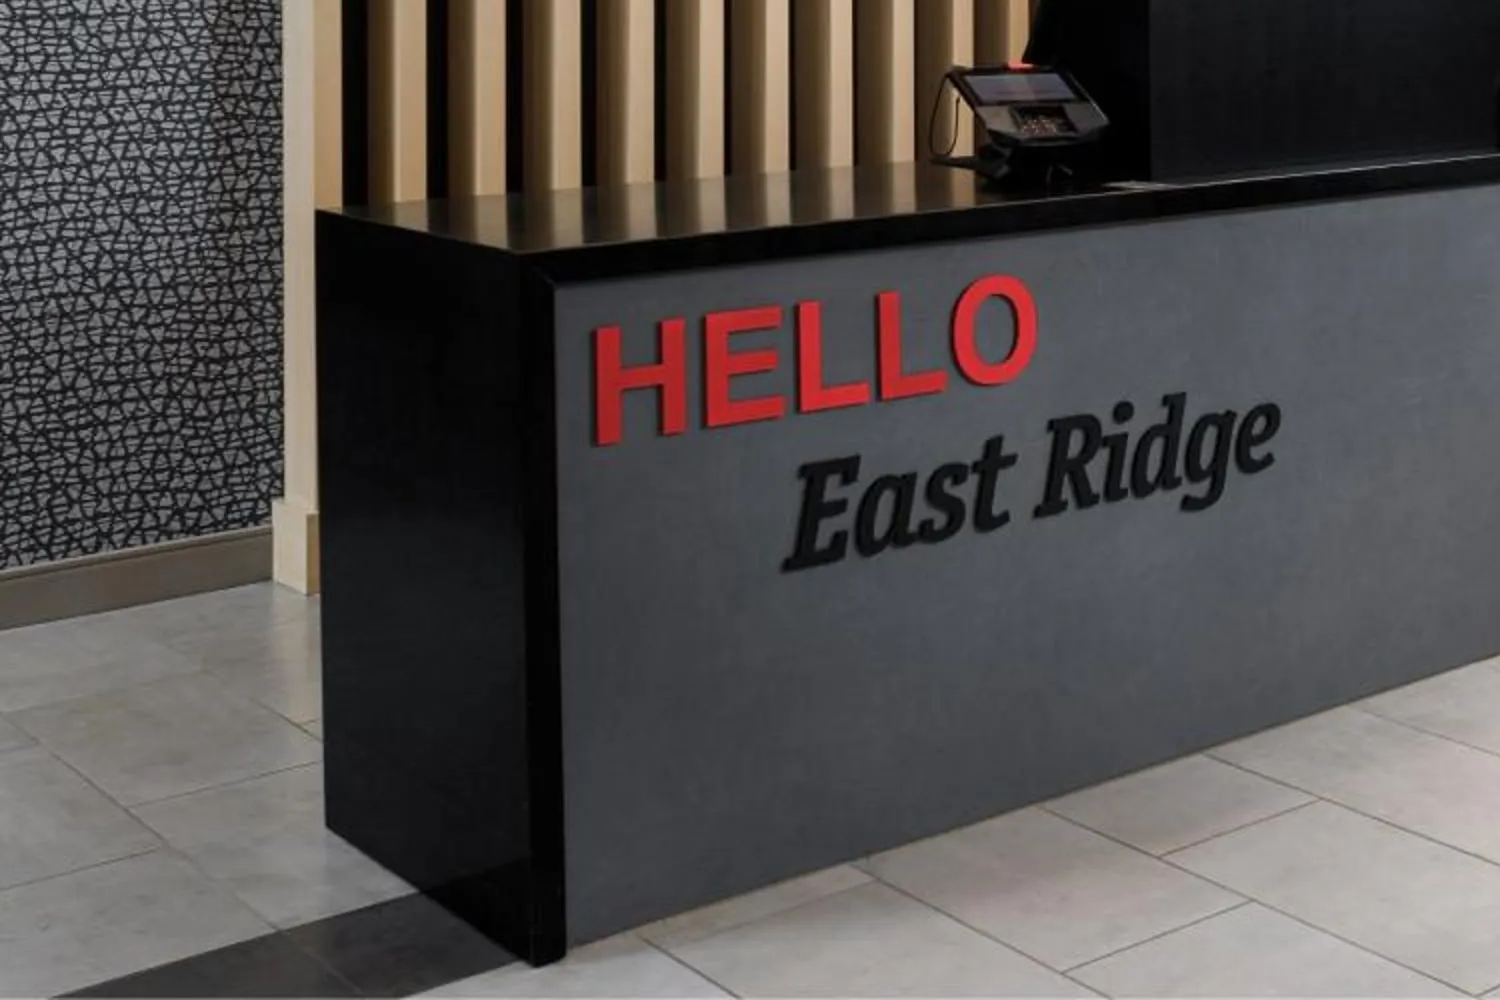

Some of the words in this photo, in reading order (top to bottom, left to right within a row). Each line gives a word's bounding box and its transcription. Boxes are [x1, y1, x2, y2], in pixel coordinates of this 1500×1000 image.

[592, 275, 1038, 446] HELLO
[780, 434, 1018, 573] East
[1031, 391, 1281, 519] Ridge
